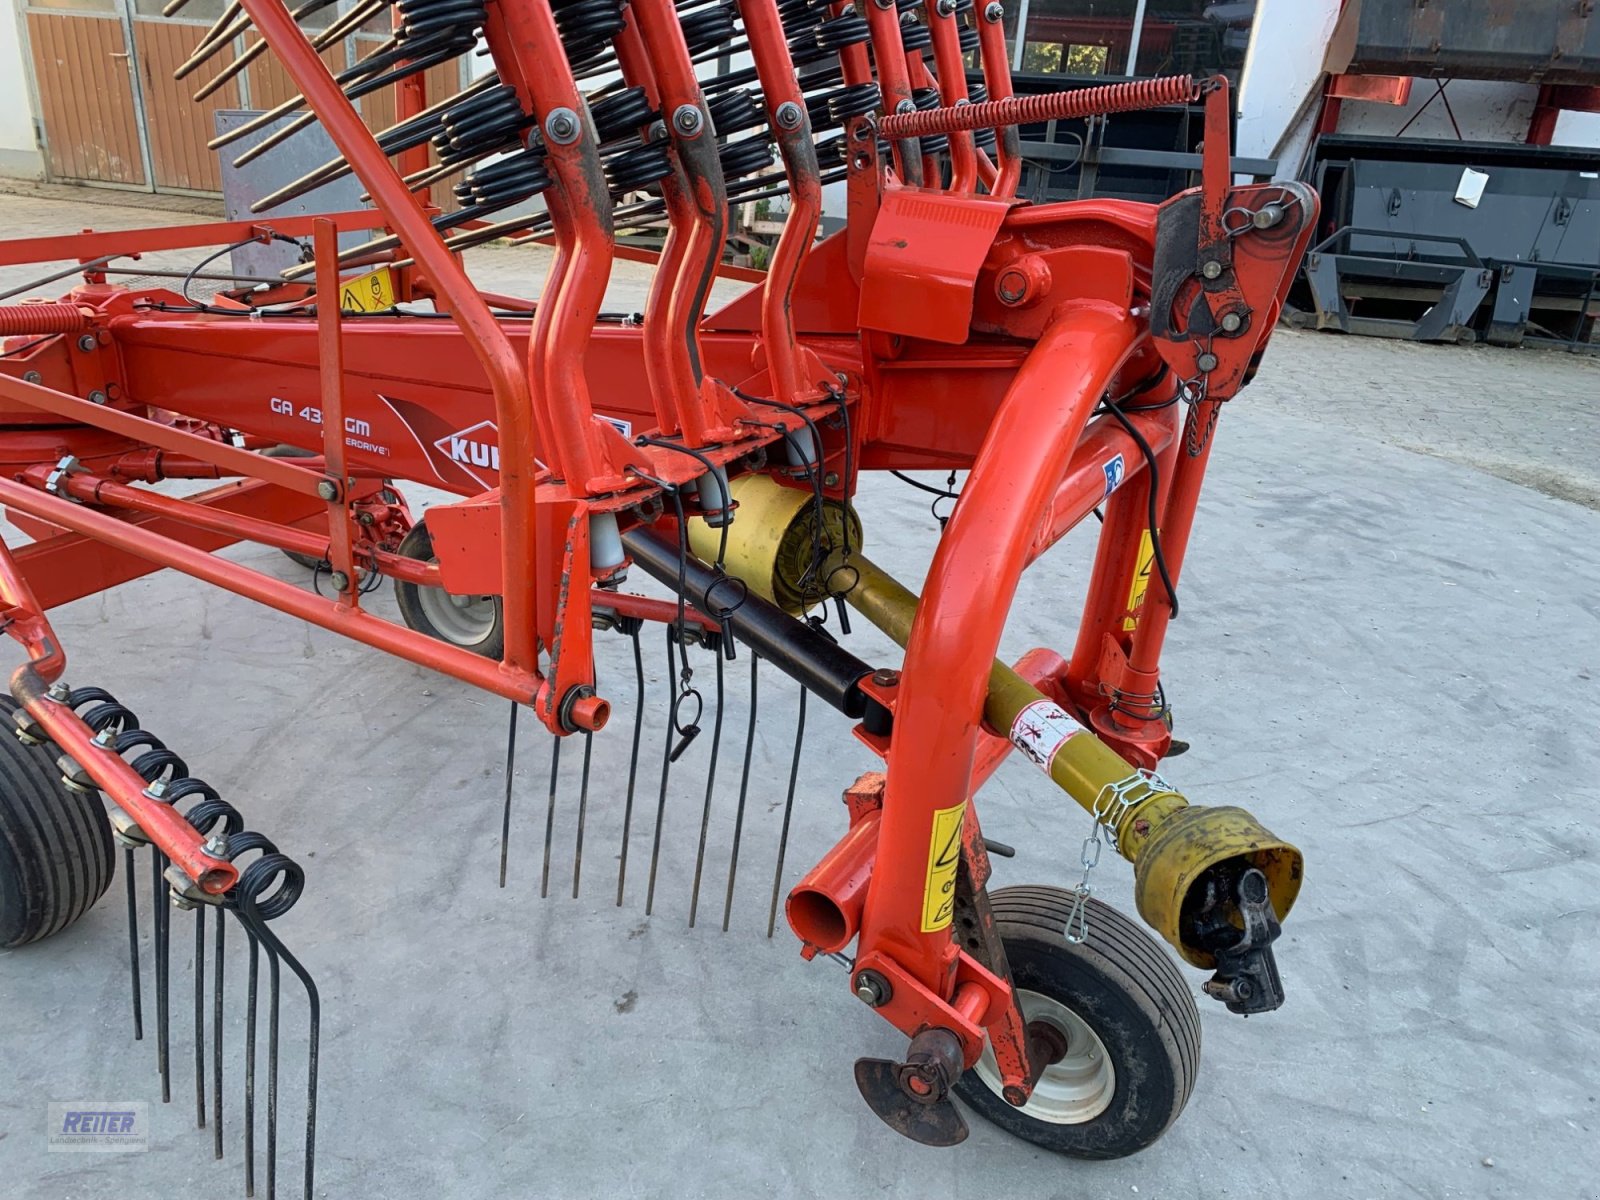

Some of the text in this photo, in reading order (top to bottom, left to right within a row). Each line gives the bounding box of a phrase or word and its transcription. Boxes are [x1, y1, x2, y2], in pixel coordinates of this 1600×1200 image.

[270, 397, 370, 437] GA 43 GM
